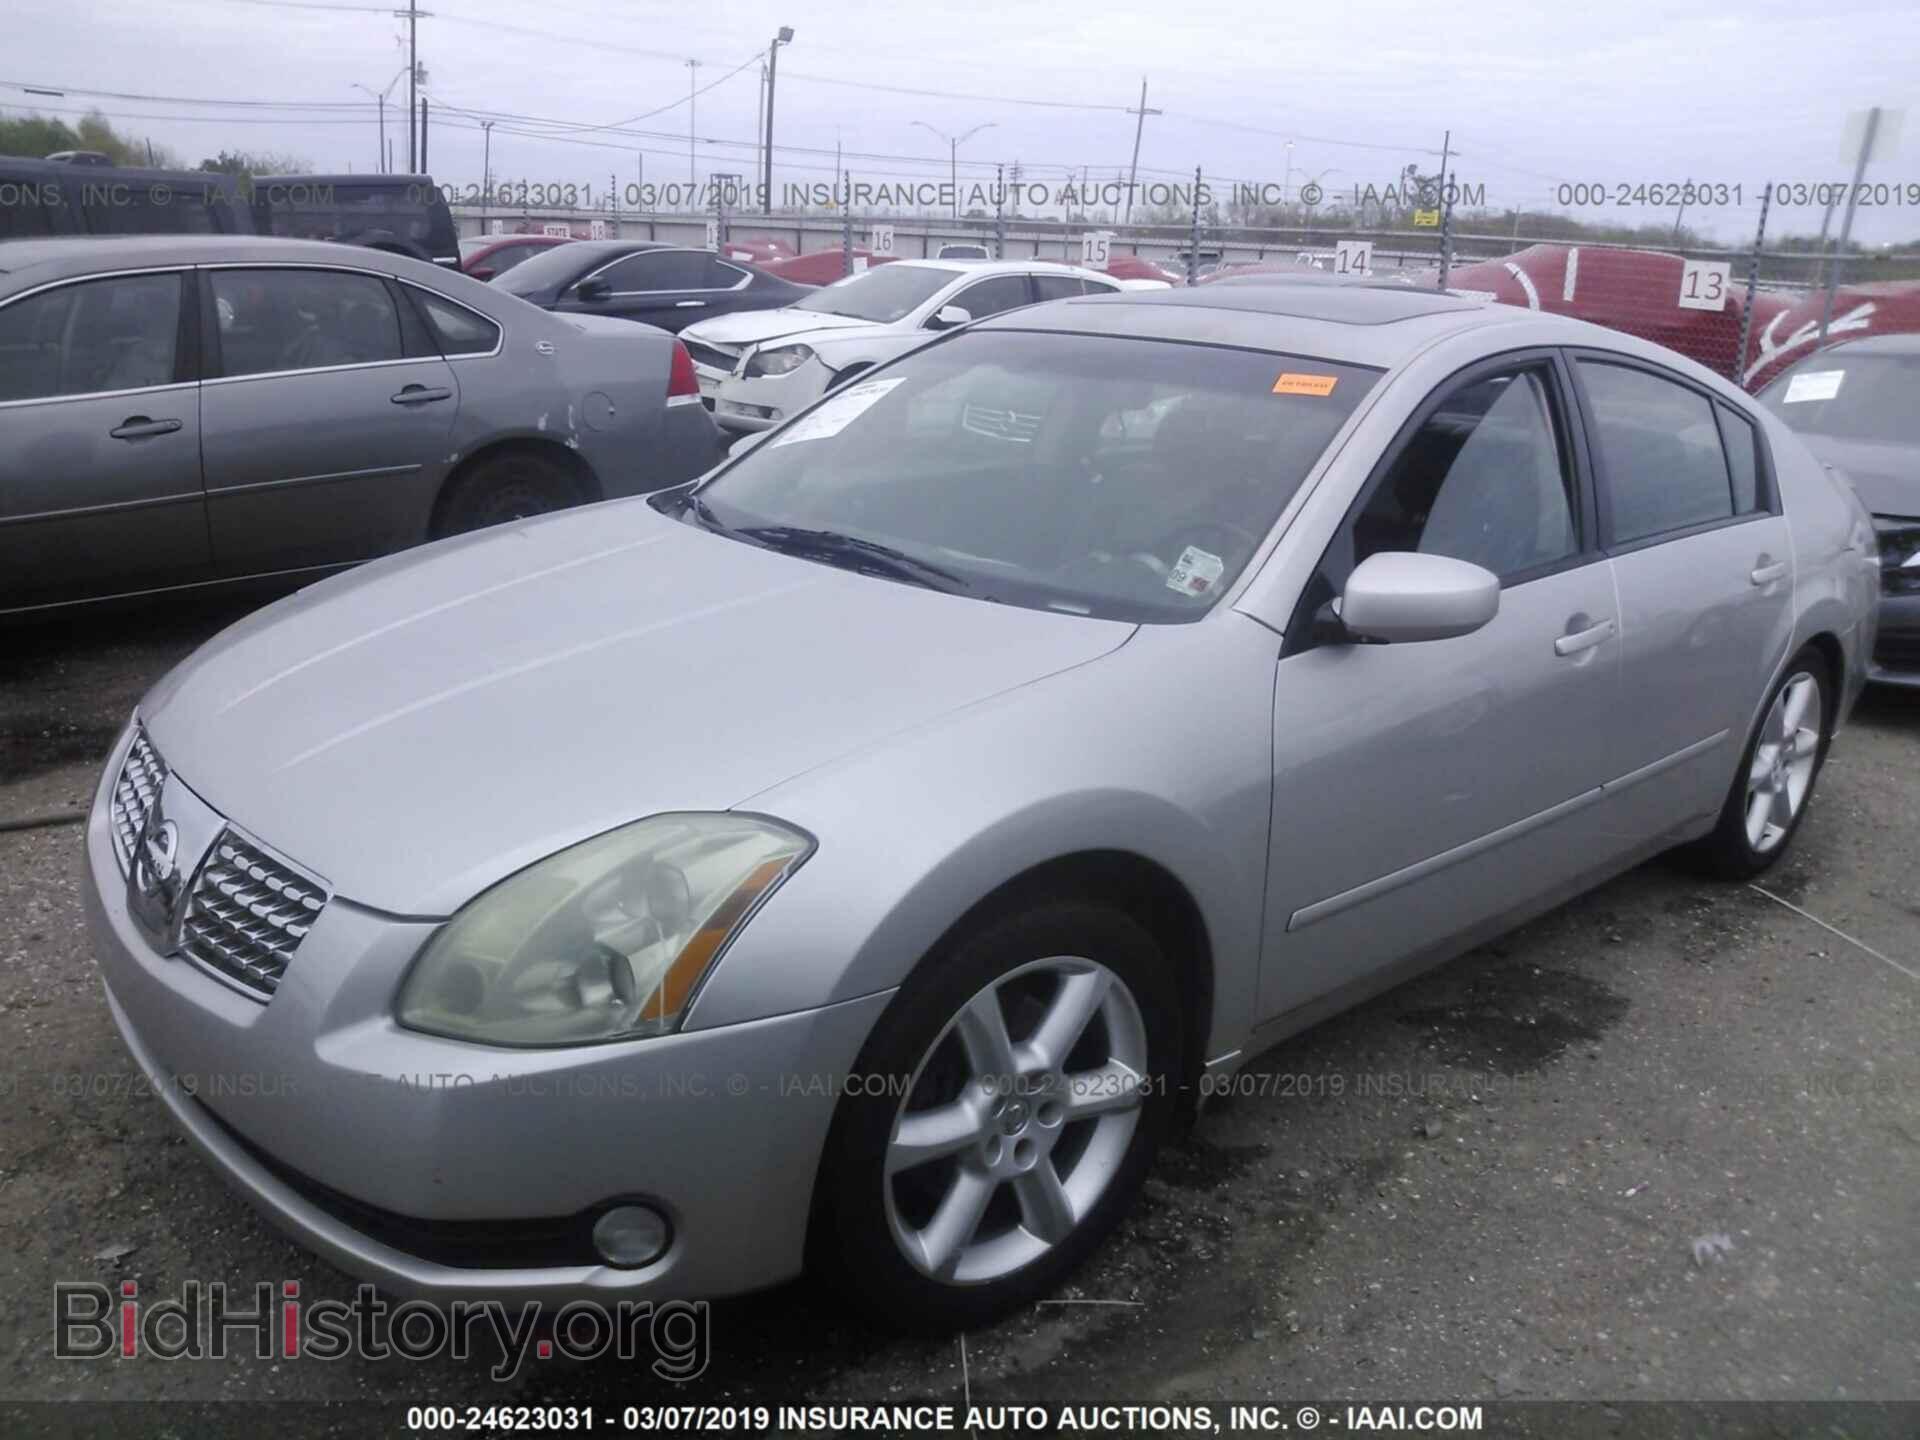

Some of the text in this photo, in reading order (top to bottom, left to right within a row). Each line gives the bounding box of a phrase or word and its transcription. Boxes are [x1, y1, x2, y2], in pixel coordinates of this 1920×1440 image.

[874, 231, 892, 250] 16
[1085, 239, 1107, 263] 15
[1338, 250, 1367, 274] 14
[1684, 270, 1724, 300] 13
